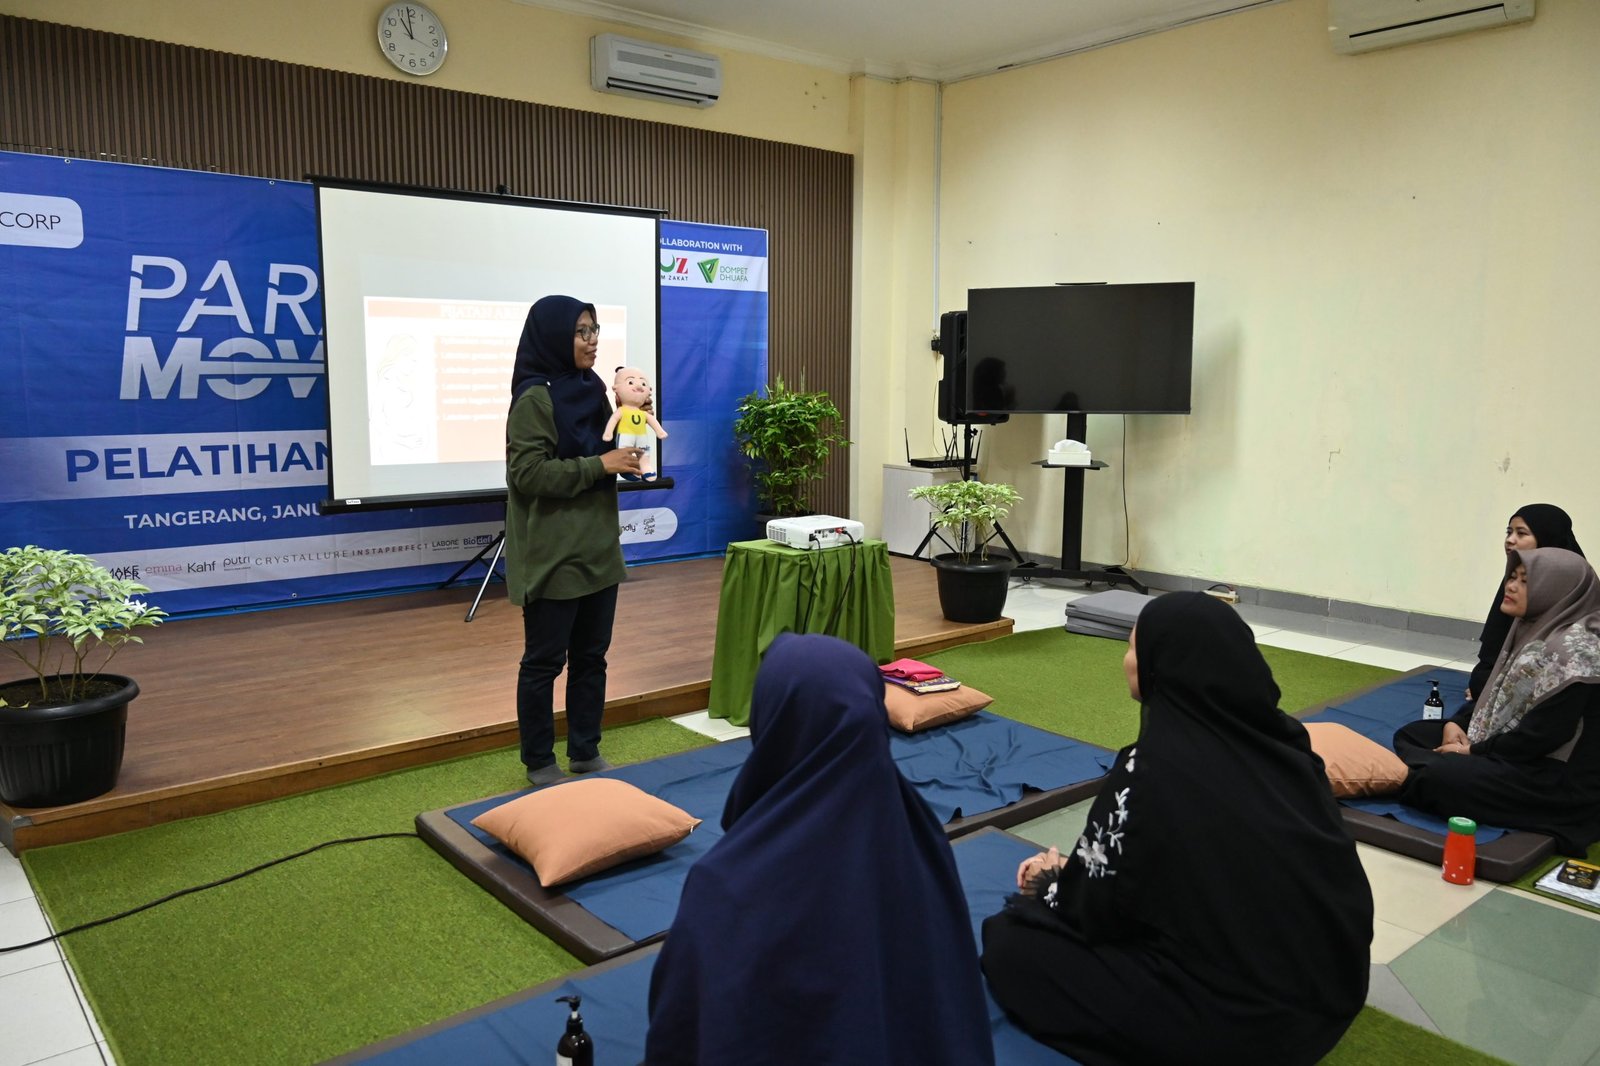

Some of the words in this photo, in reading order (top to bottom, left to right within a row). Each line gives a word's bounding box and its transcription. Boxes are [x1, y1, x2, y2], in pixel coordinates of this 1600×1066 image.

[388, 18, 396, 26] 10
[384, 30, 392, 38] 9
[428, 26, 435, 34] 2
[388, 42, 396, 52] 8
[432, 38, 438, 48] 3
[399, 54, 405, 62] 7
[420, 58, 427, 67] 5
[409, 59, 417, 68] 6
[722, 242, 743, 252] WITH
[720, 266, 748, 274] DOMPET
[125, 254, 325, 336] PAR
[631, 414, 641, 425] U
[124, 506, 267, 529] TANGERANG,
[352, 543, 428, 557] INSTAPERFECT
[255, 550, 348, 566] CRYSTALLURE
[145, 563, 183, 574] emina
[187, 560, 217, 573] Kahf
